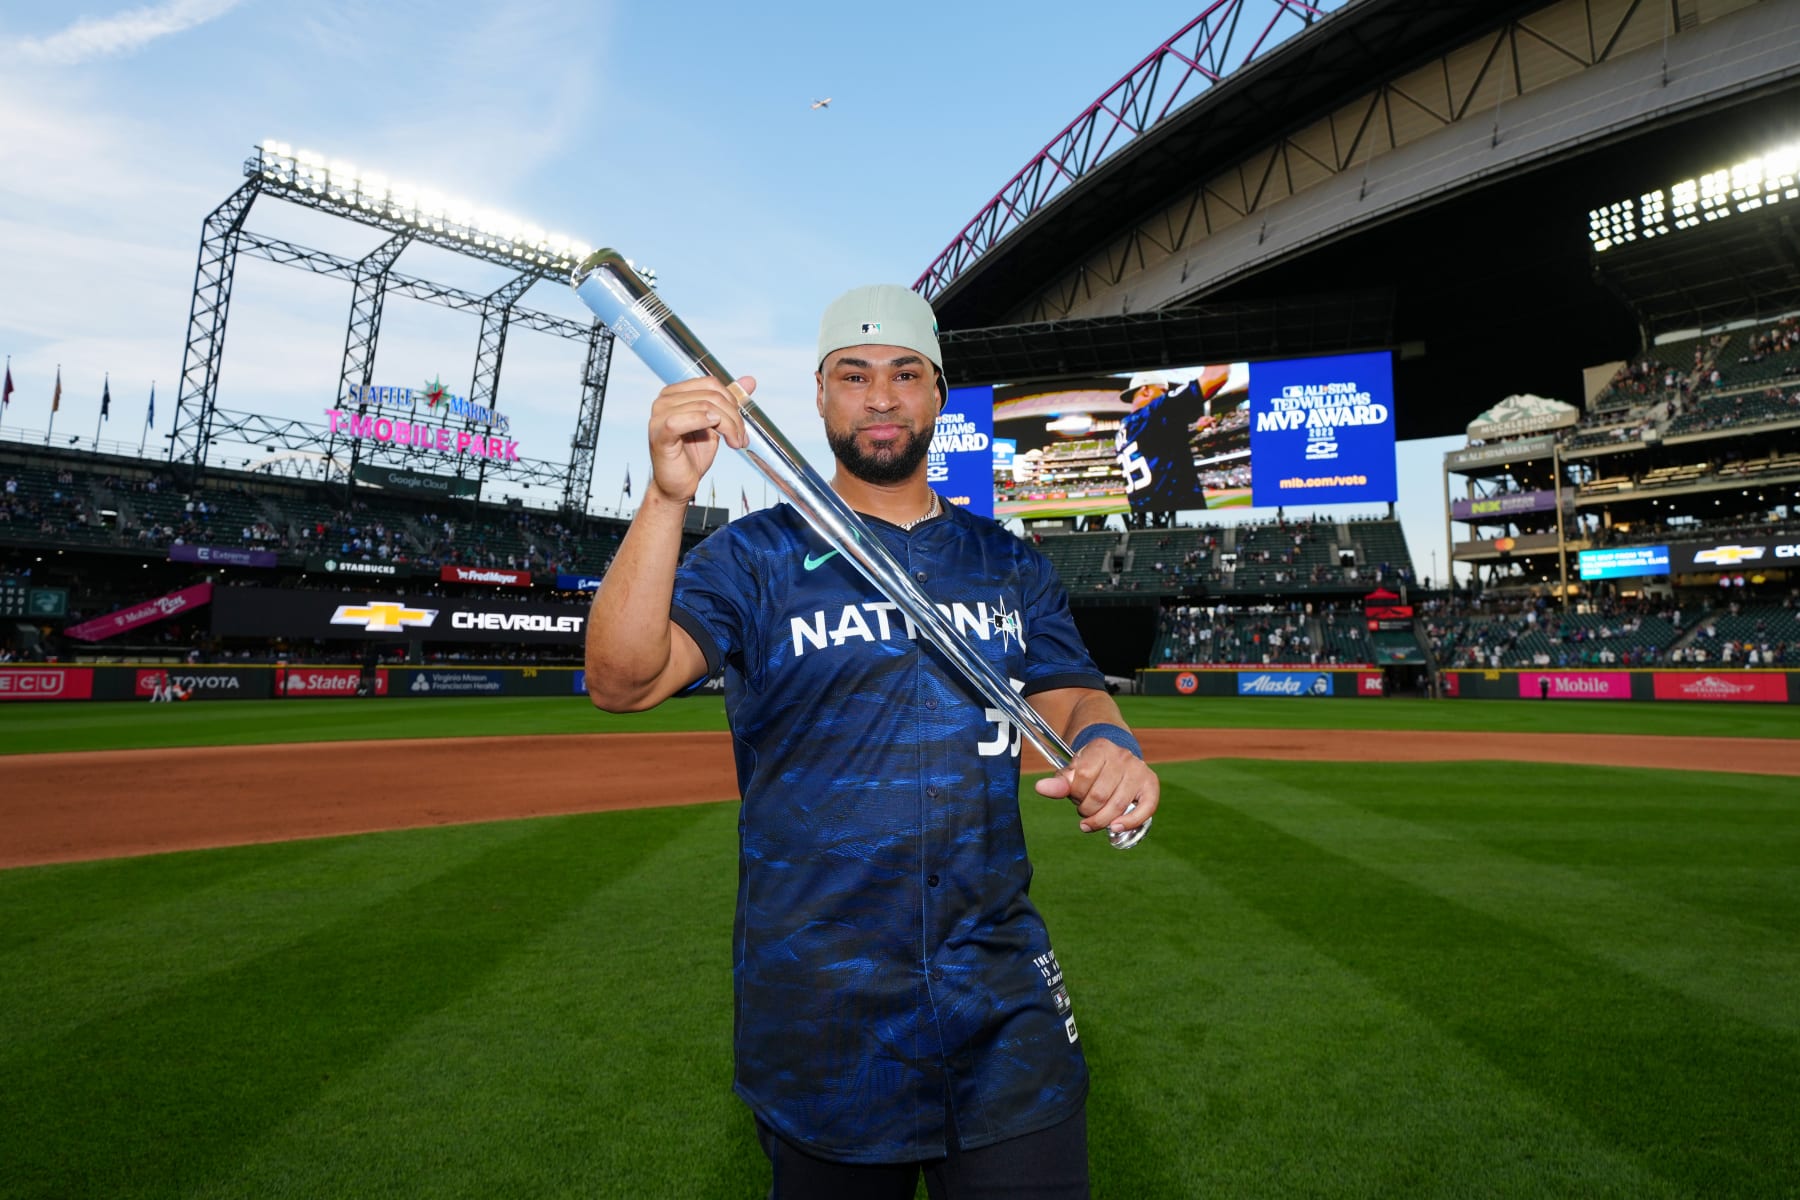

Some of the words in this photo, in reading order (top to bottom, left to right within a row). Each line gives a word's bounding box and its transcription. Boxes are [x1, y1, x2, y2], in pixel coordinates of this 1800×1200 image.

[348, 383, 414, 407] SEATTLE
[450, 394, 509, 432] MARINERS
[1271, 397, 1300, 411] TED
[1300, 392, 1371, 410] WILLIAMS
[1256, 409, 1305, 432] MVP
[1305, 404, 1388, 428] AWARD
[325, 408, 450, 450] T-MOBILE
[456, 431, 520, 462] PARK
[1309, 427, 1334, 437] 2023
[388, 473, 421, 489] Google
[423, 476, 448, 490] Cloud
[1280, 475, 1367, 489] mlb.com/vote
[339, 562, 396, 574] STARBUCKS
[452, 612, 584, 632] CHEVROLET
[172, 676, 239, 689] TOYOTA
[474, 682, 500, 690] Health
[1179, 677, 1194, 688] 76
[1243, 675, 1300, 694] Alaska
[1555, 677, 1608, 692] Mobile
